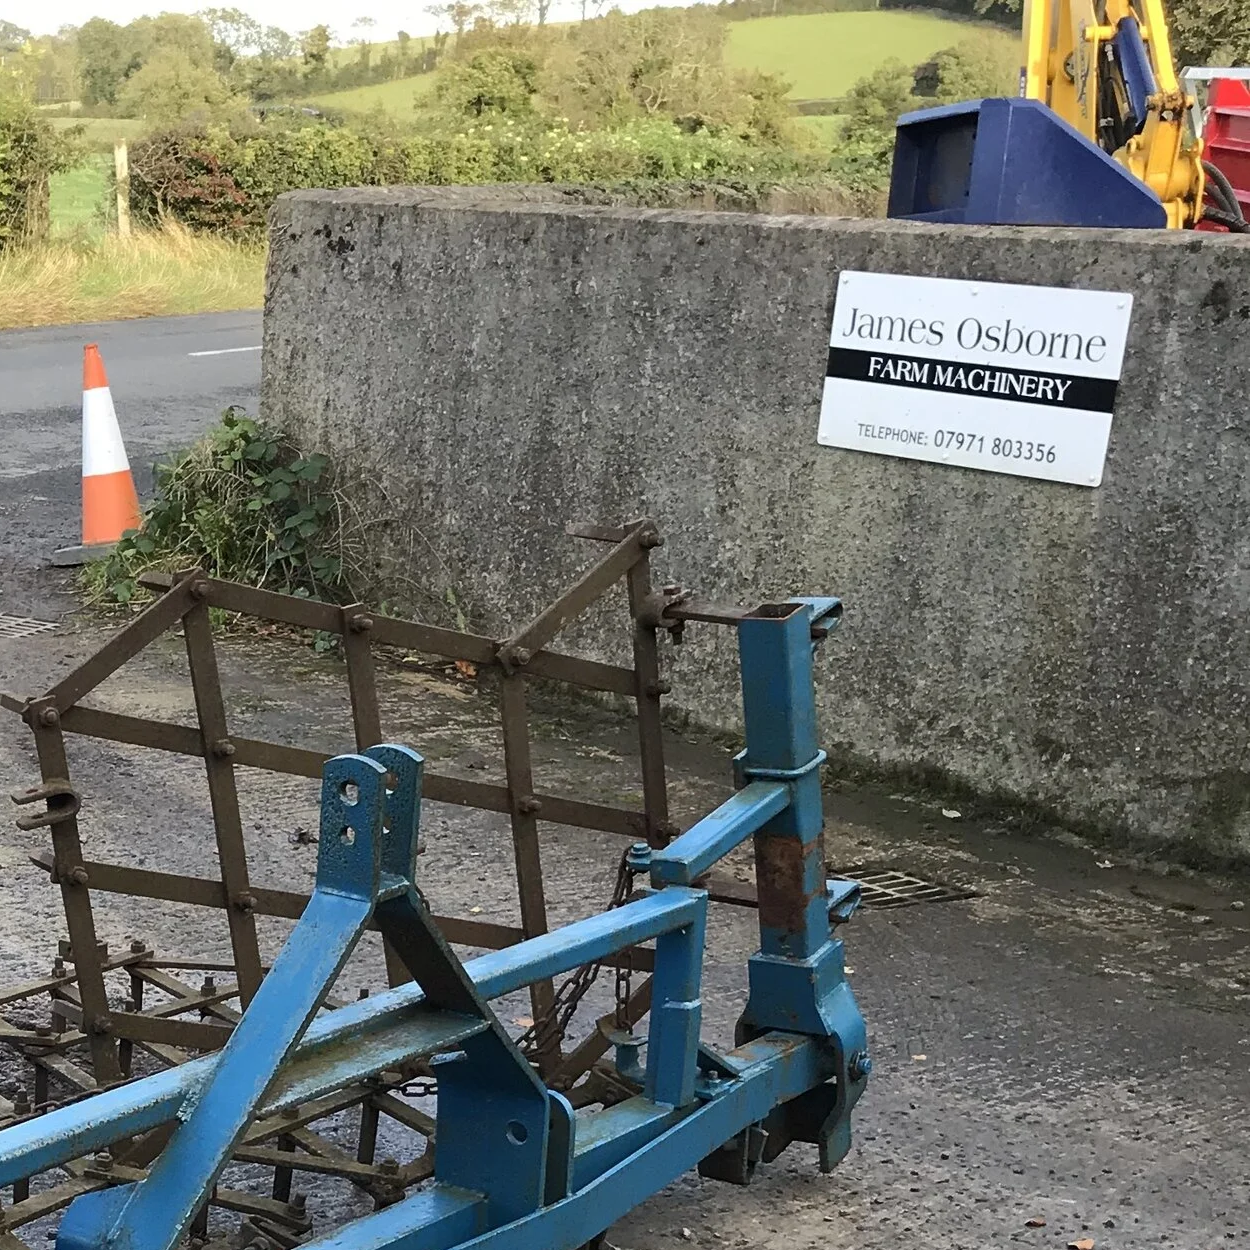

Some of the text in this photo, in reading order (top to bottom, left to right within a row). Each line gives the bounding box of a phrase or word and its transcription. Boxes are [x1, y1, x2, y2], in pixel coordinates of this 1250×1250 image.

[842, 307, 1106, 363] James Osborne
[867, 356, 1072, 401] FARM MACHINERY
[857, 423, 1056, 464] TELEPHONE: 07971 803356
